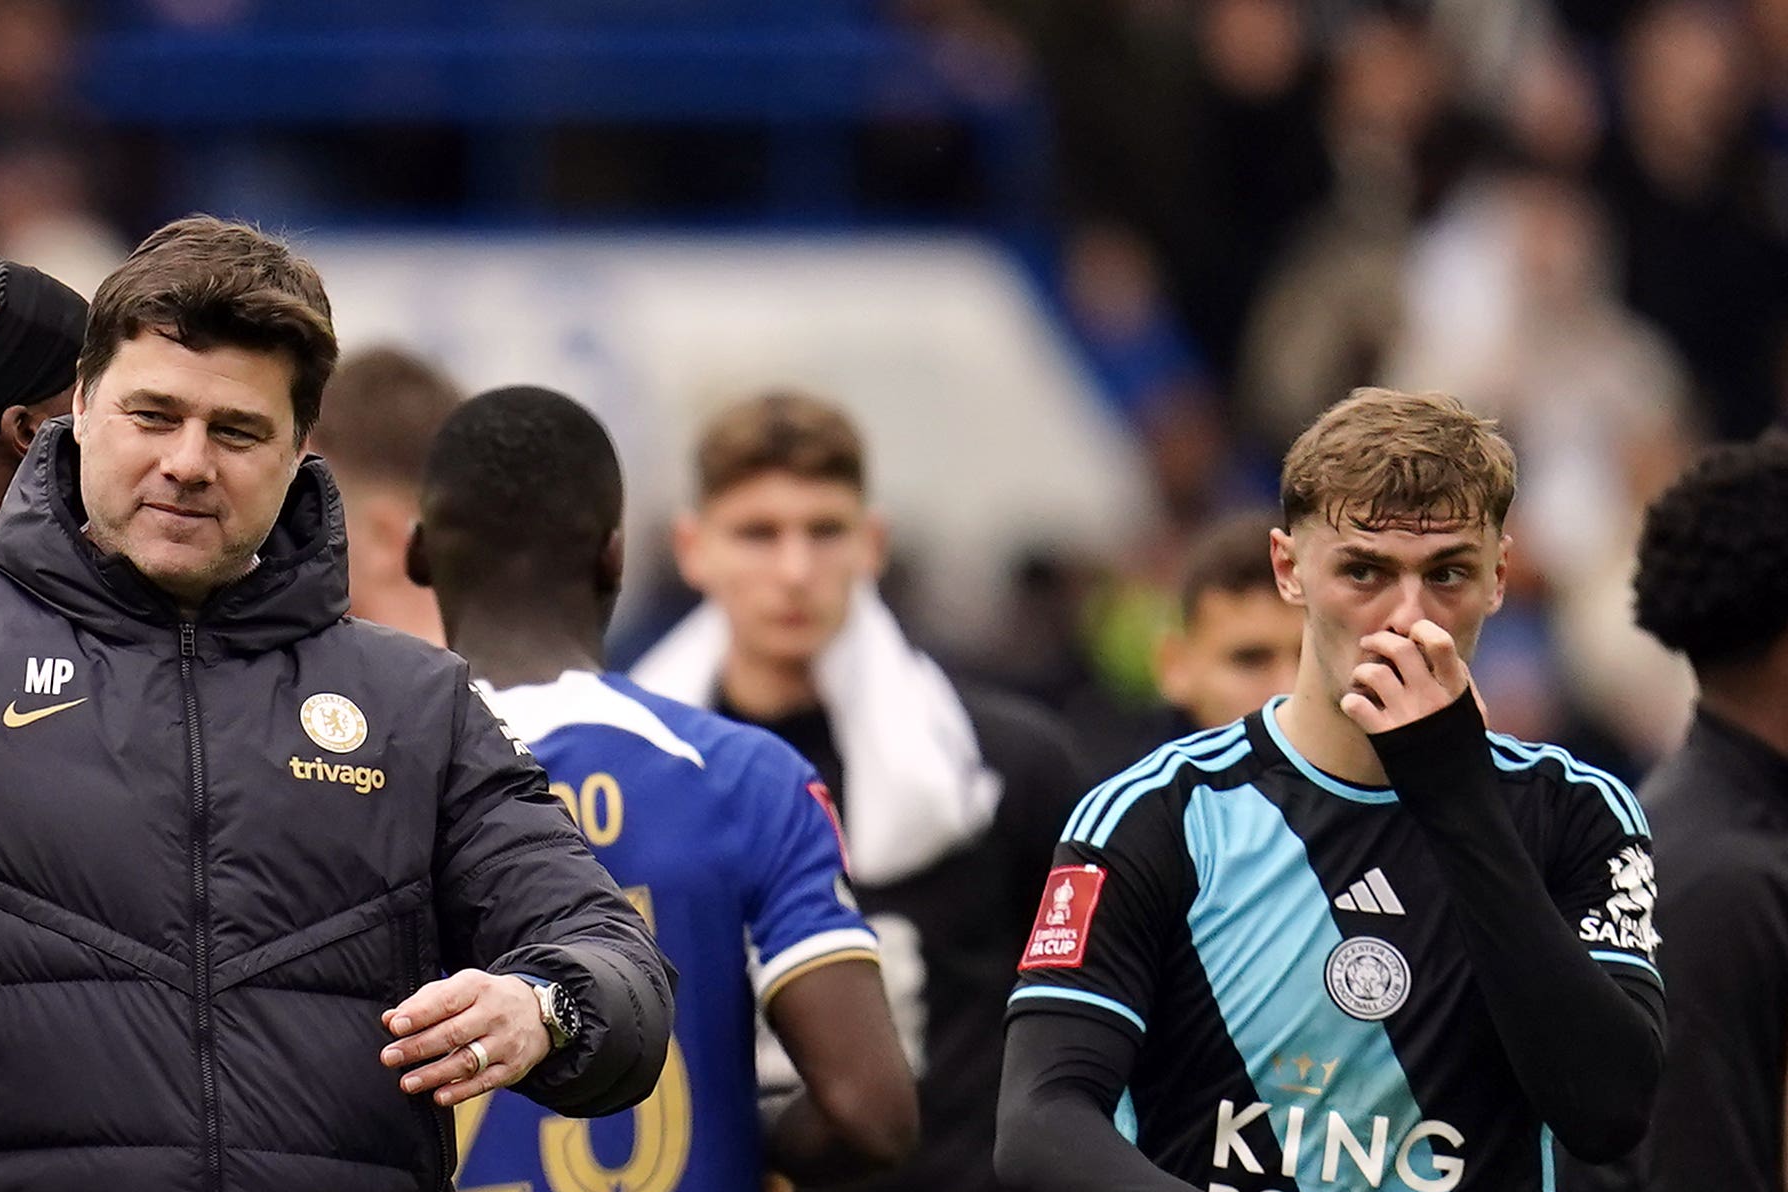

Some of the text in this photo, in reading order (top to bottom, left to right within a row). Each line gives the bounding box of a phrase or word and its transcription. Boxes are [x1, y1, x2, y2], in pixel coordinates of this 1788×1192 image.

[24, 656, 75, 696] MP
[288, 756, 386, 794] trivago
[1044, 939, 1077, 956] CUP
